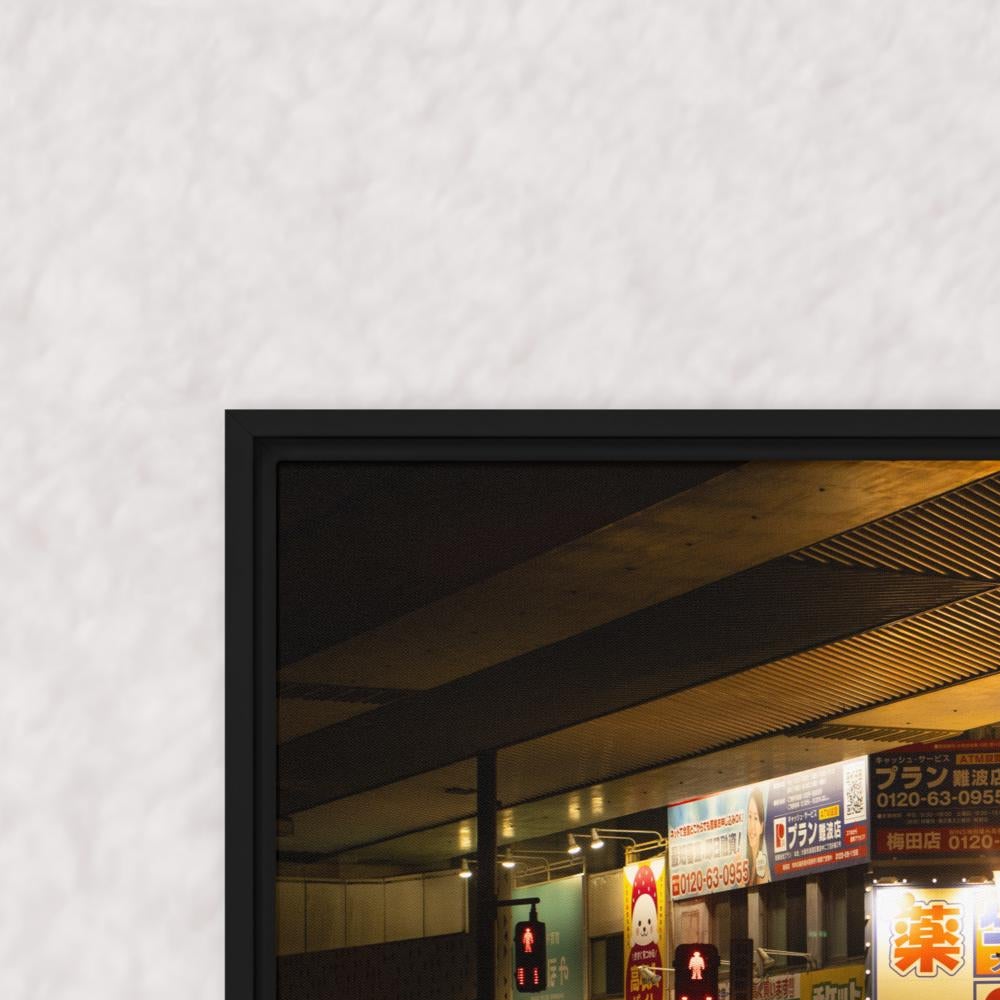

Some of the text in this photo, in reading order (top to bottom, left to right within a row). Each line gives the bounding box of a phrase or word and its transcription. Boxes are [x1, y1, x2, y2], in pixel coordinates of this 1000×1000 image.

[875, 764, 949, 791] プラン
[787, 822, 819, 850] プラン
[886, 831, 942, 851] 梅田店
[679, 859, 750, 896] 0120-63-0955
[894, 903, 961, 974] 薬
